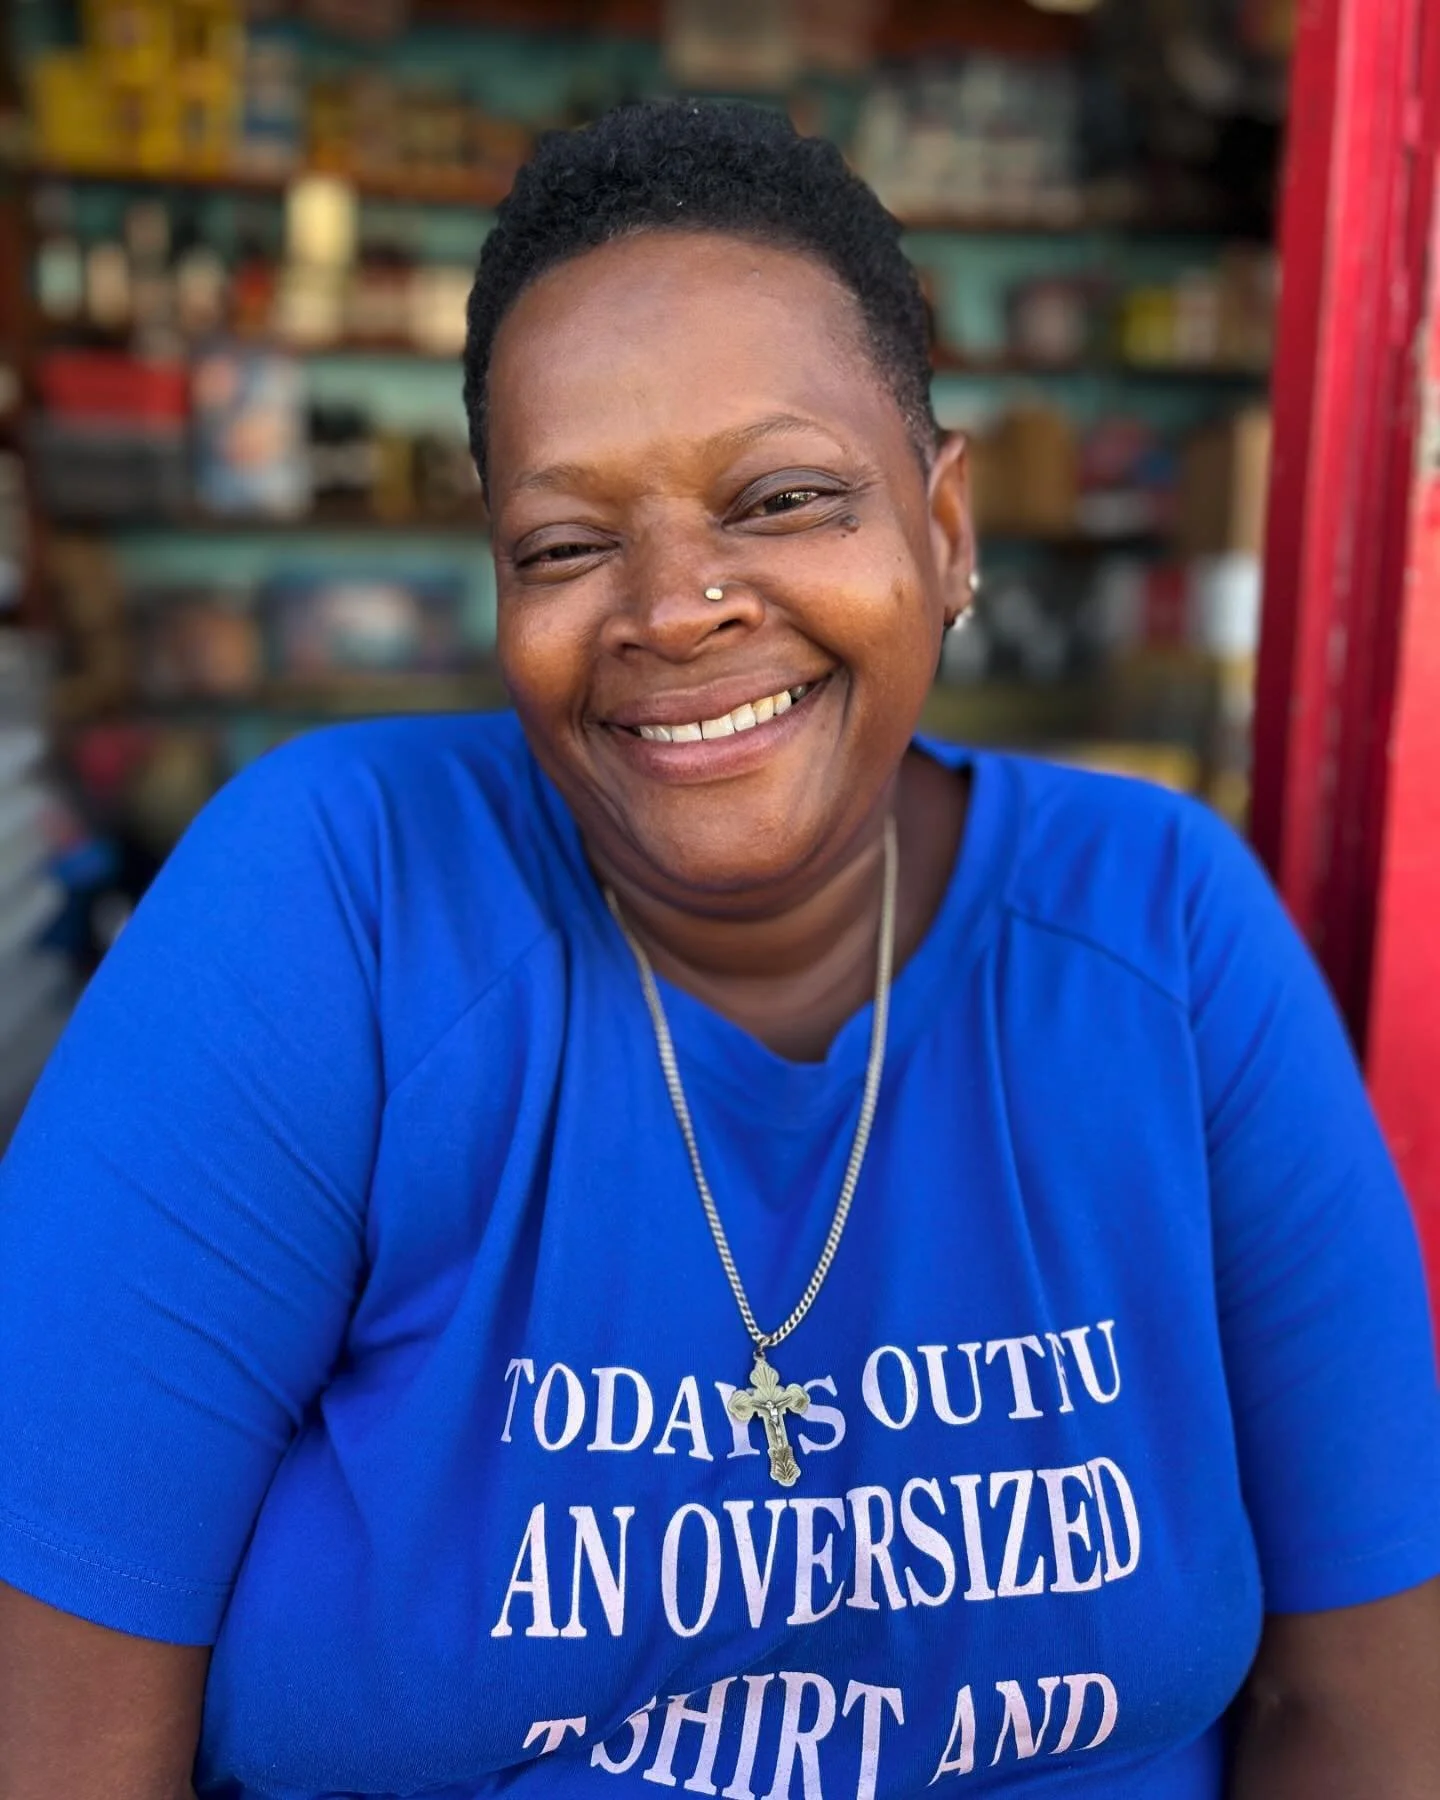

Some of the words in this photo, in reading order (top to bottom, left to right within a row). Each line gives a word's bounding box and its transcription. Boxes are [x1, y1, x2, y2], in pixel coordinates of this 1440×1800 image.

[490, 1502, 636, 1638] AN
[661, 1456, 1141, 1638] OVERSIZED
[927, 1672, 1118, 1786] AND
